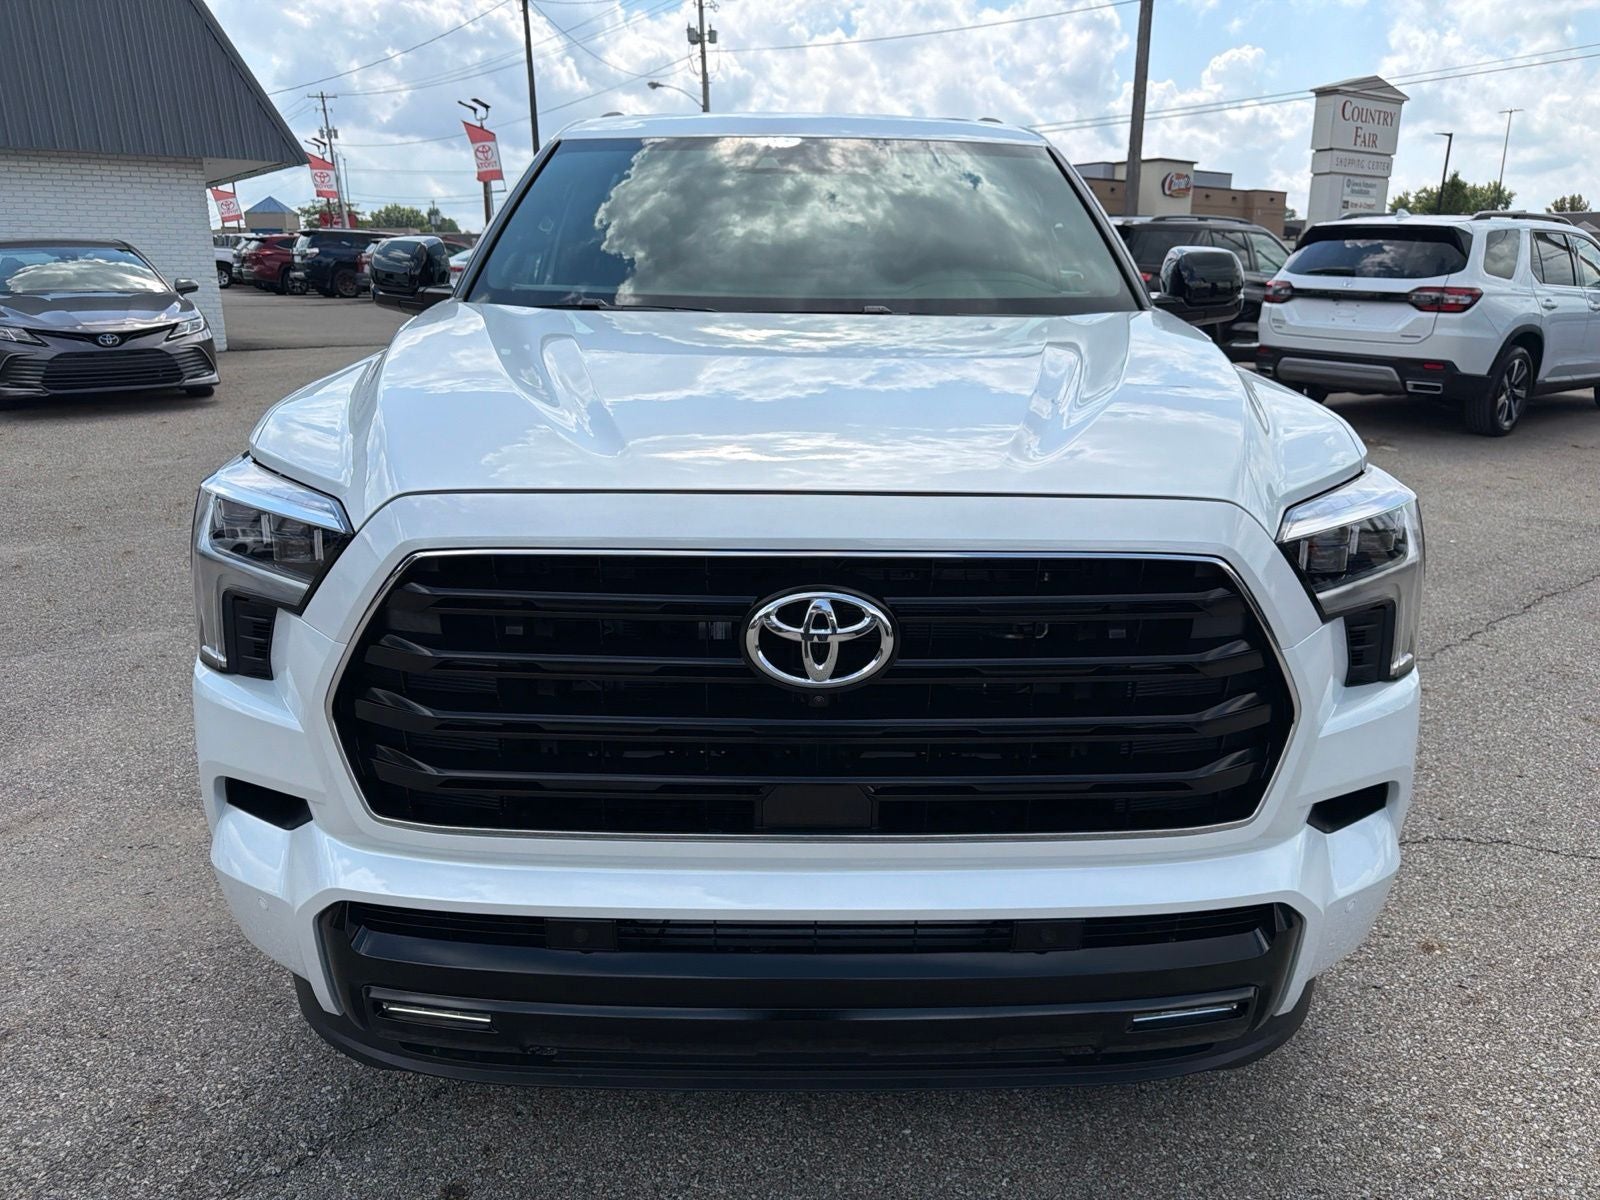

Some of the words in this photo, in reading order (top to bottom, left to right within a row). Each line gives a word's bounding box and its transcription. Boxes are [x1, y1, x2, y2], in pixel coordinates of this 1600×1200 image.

[1341, 100, 1396, 127] COUNTRY
[1353, 126, 1378, 149] FAIR
[1335, 156, 1365, 169] SHOPPING
[1368, 160, 1390, 171] CENTER
